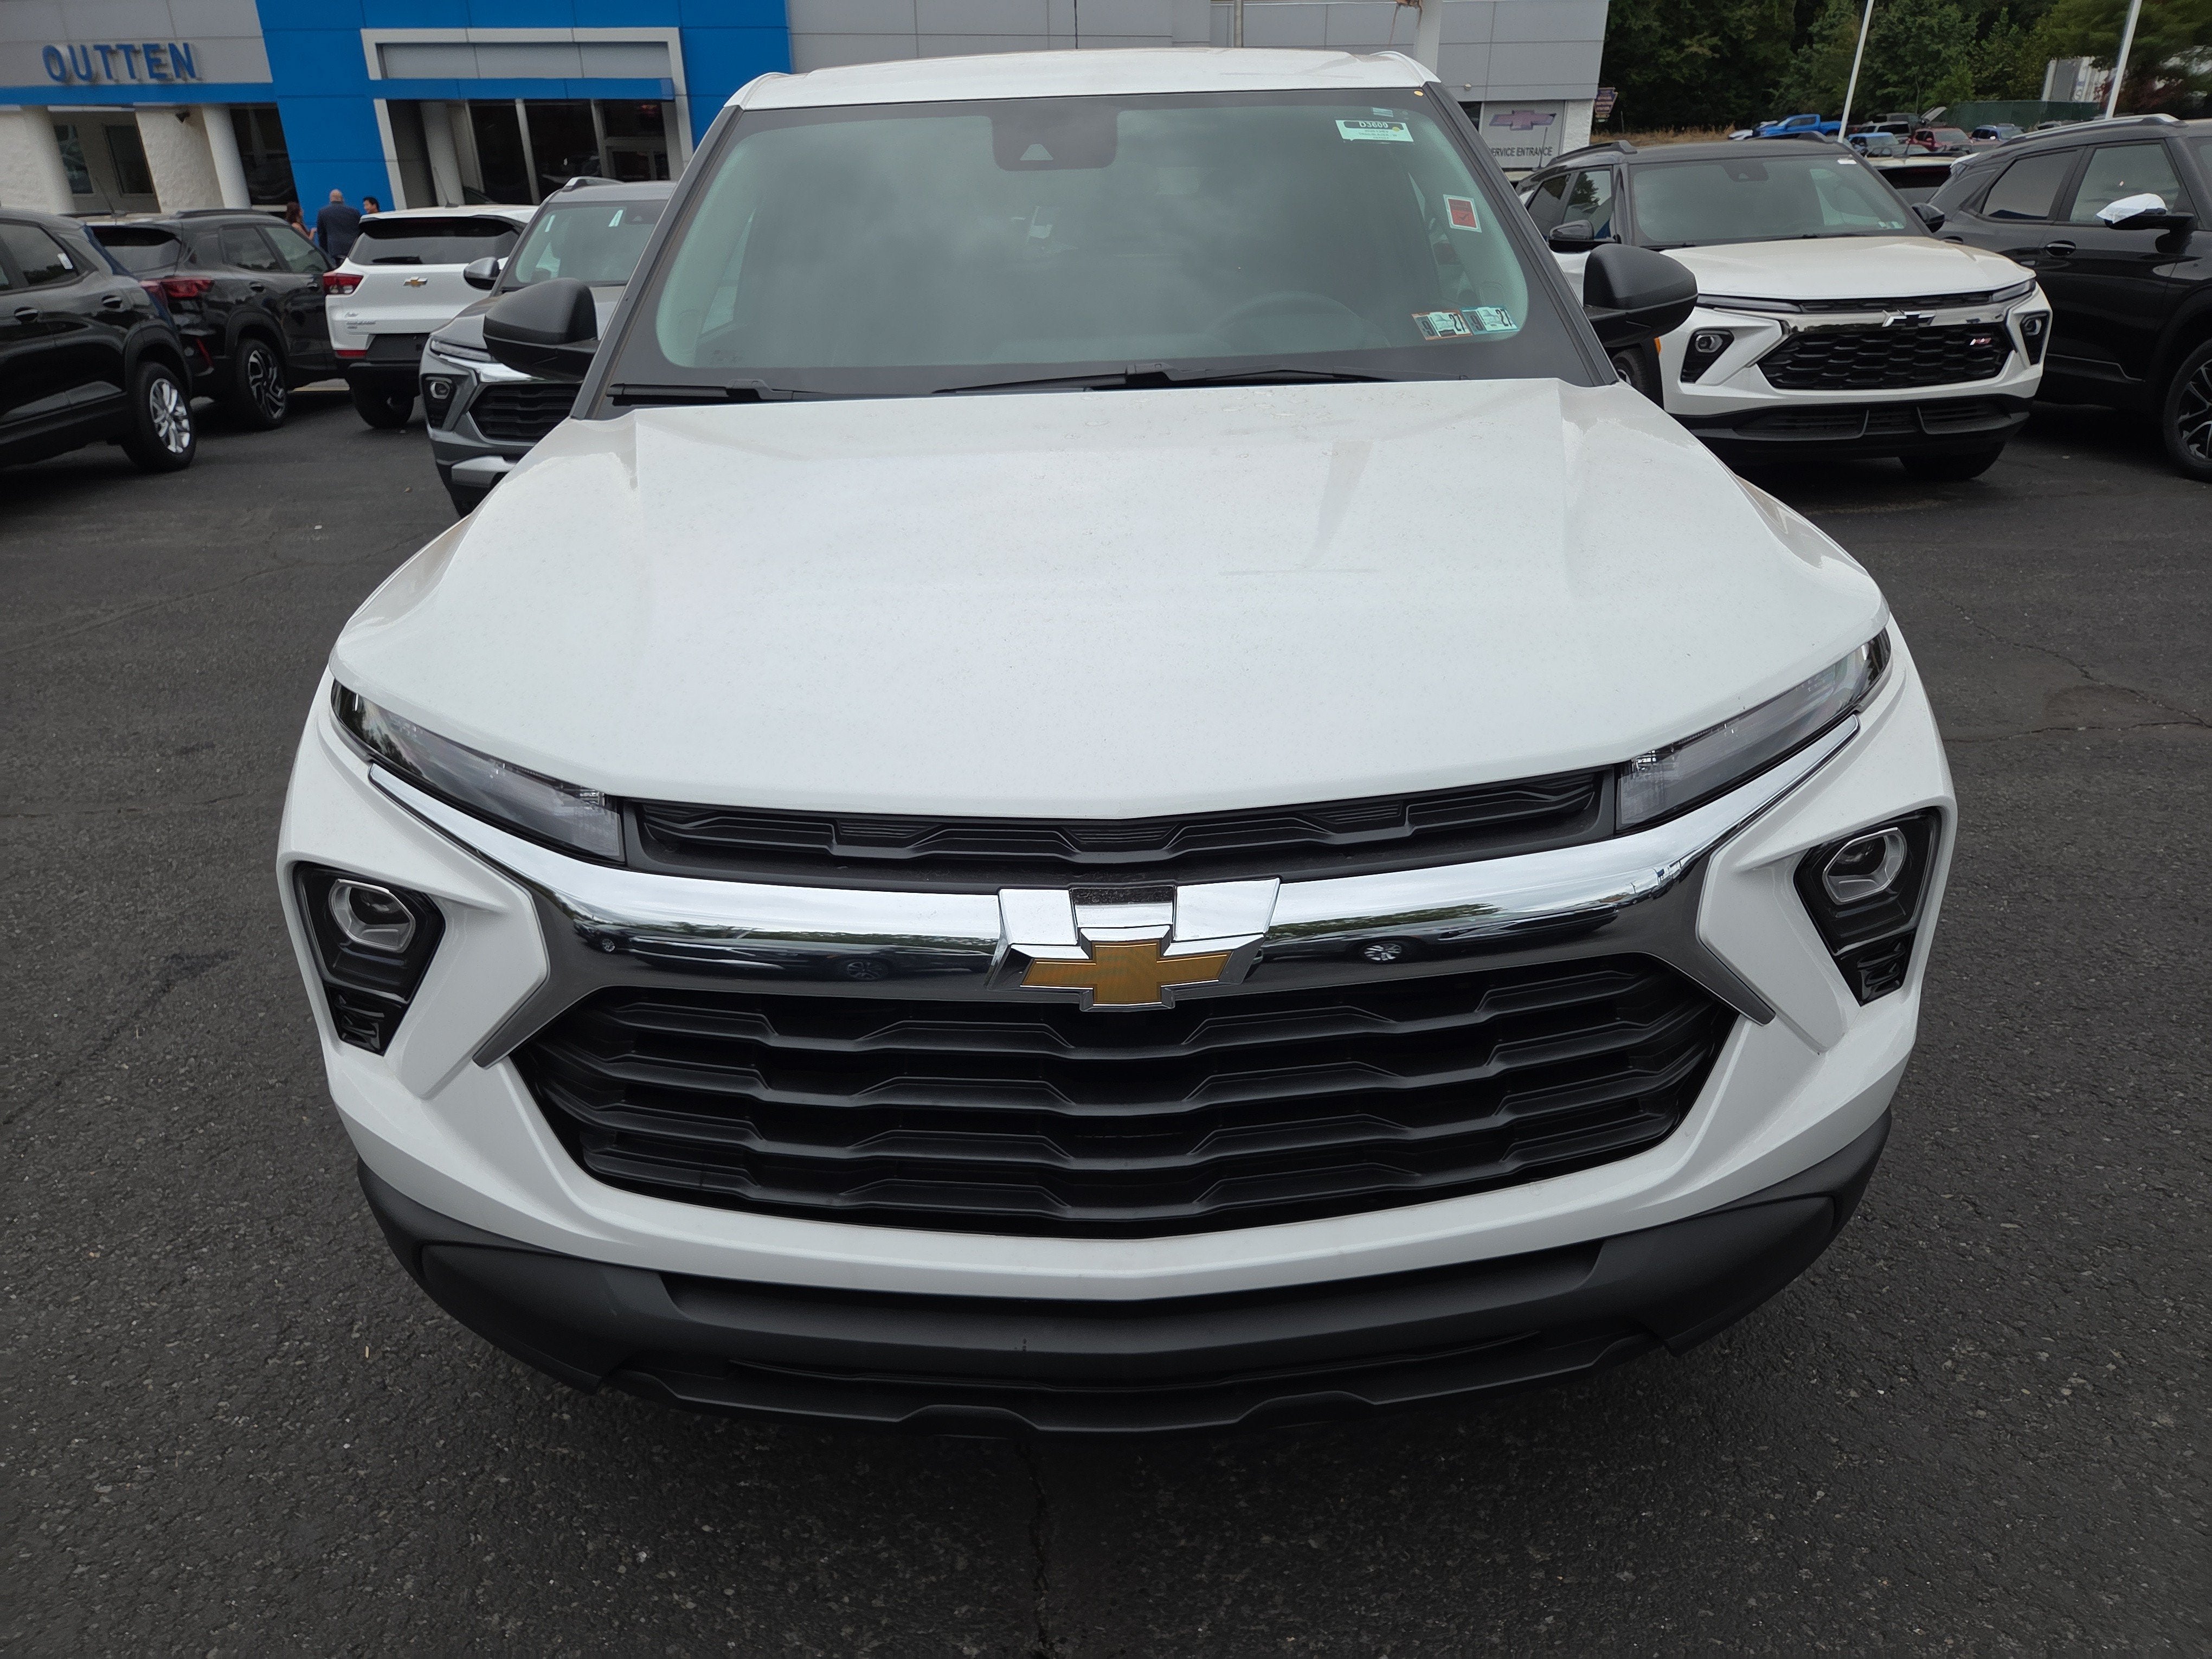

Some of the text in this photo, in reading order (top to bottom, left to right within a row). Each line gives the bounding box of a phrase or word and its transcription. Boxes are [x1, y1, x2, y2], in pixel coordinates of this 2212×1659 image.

[42, 42, 196, 81] OUTTEN
[1490, 146, 1553, 157] ERVICE ENTRANCE
[1421, 320, 1436, 337] 9
[1448, 313, 1466, 333] 27
[1470, 308, 1513, 331] 9 27
